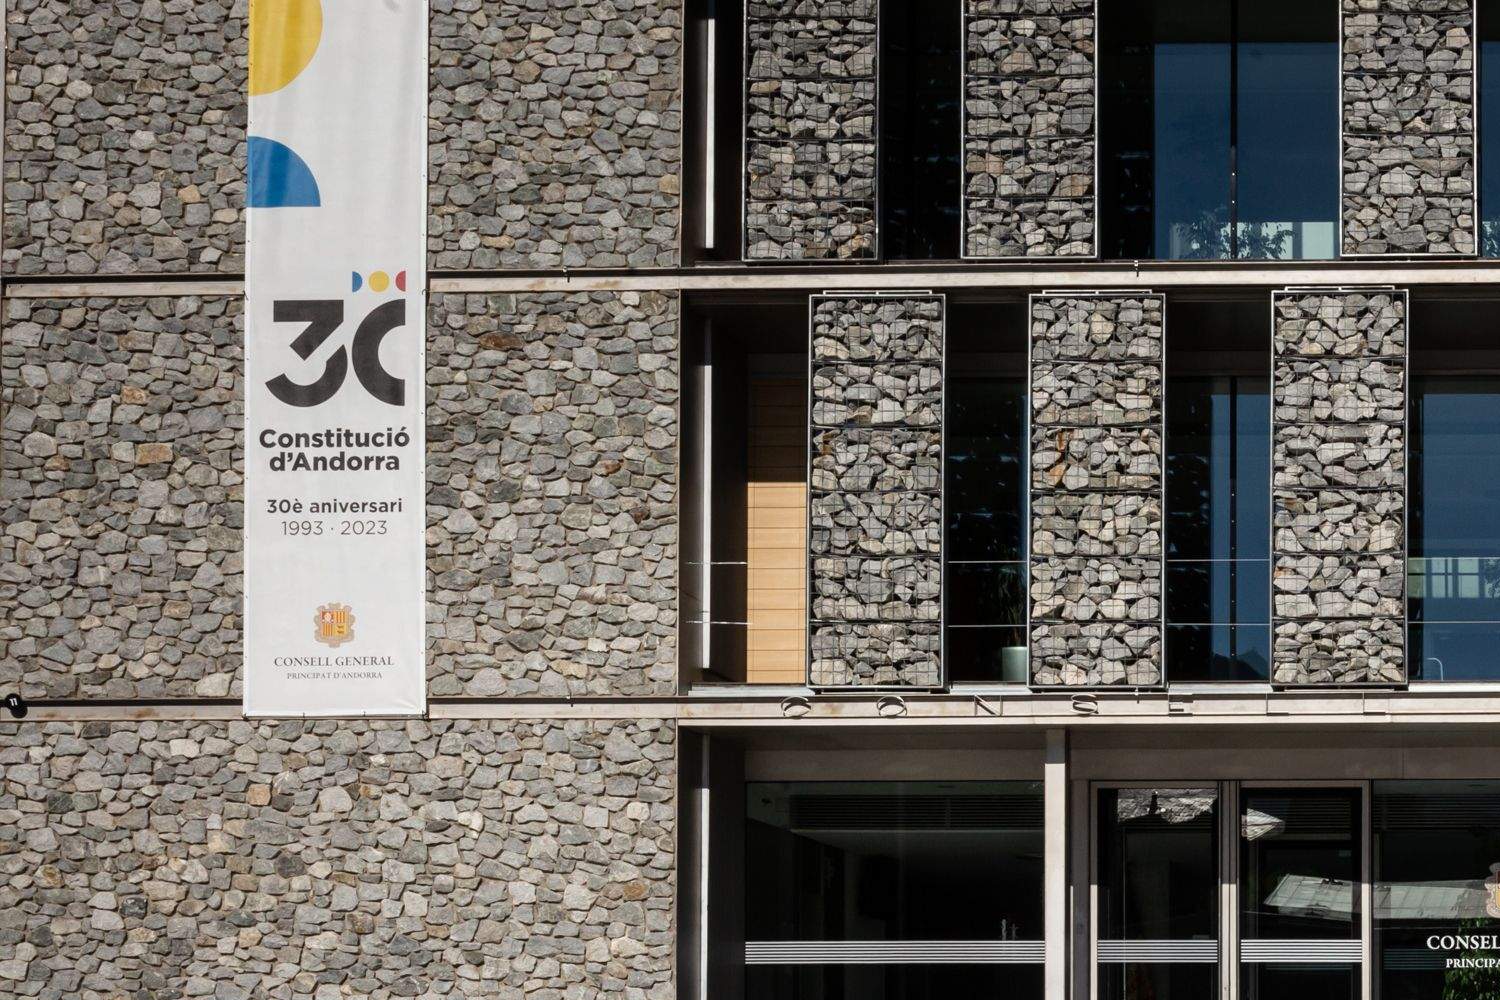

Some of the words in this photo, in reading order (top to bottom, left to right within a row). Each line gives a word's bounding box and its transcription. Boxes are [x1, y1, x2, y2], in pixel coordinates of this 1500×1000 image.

[259, 427, 410, 448] Constitució
[267, 499, 303, 513] 30è
[310, 498, 403, 513] aniversari
[282, 521, 323, 535] 1993
[341, 520, 388, 535] 2023
[274, 656, 332, 667] CONSELL
[335, 655, 394, 667] GENERAL
[287, 672, 332, 680] PRINCIPAT
